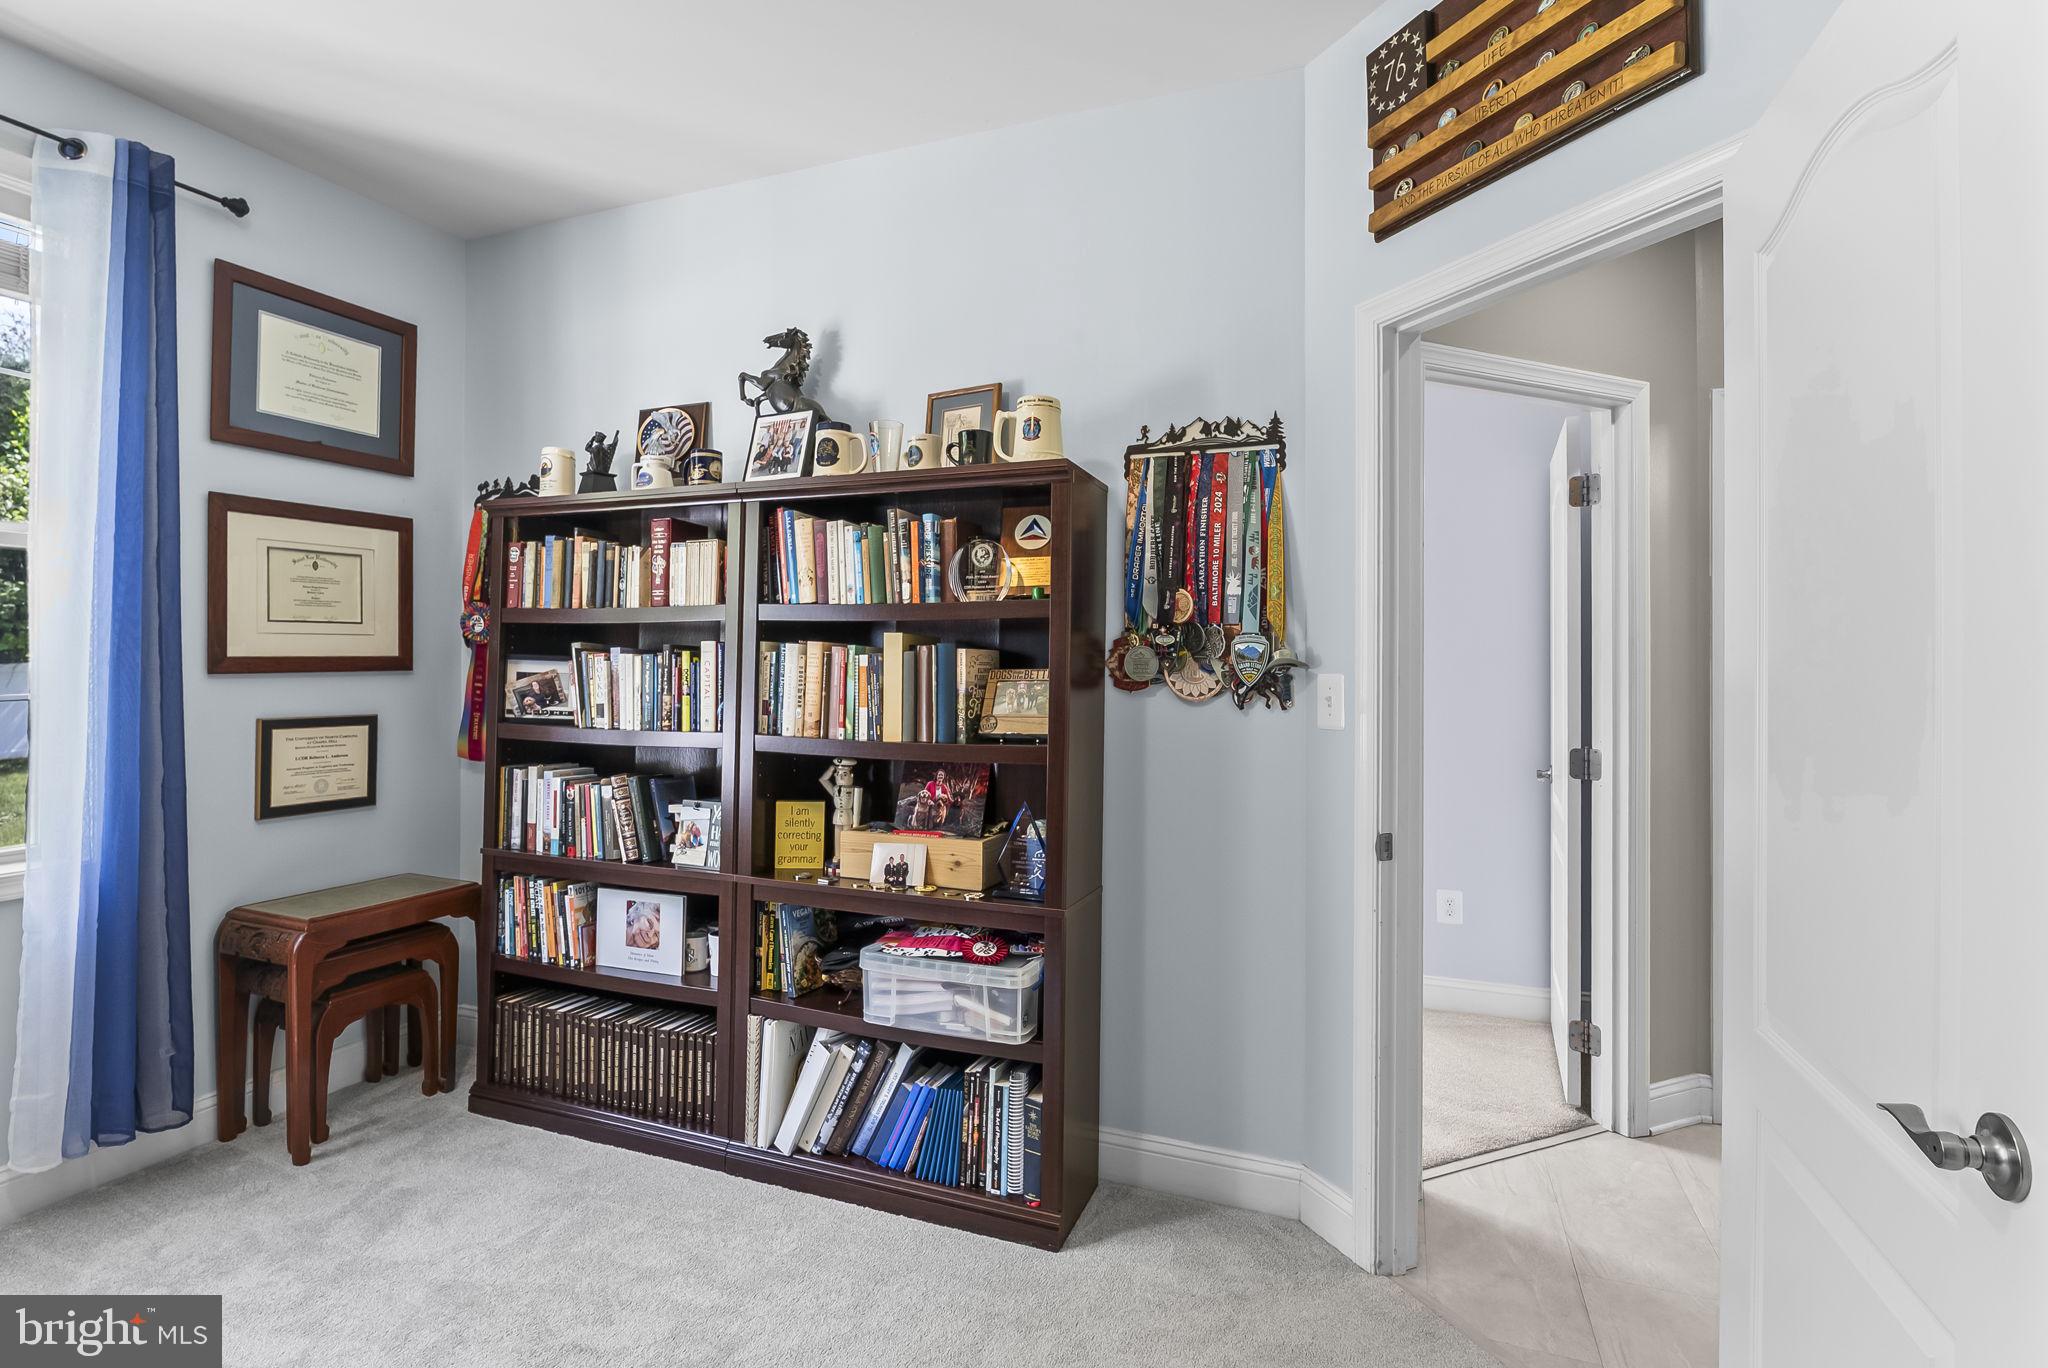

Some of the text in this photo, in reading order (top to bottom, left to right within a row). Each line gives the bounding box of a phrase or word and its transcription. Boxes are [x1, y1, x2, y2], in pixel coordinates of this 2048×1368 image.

[1482, 45, 1507, 69] LIFE
[1382, 51, 1407, 92] 76
[1474, 85, 1520, 122] LIBERTY
[1398, 76, 1625, 210] AND THE PURSUIT OF ALL WHO THREATEN IT!
[1198, 496, 1209, 590] MARATHON FINISHER
[1211, 491, 1223, 606] BALTIMORE 10 MILER 2024
[922, 540, 932, 578] PRESSURE
[1132, 545, 1142, 580] DRAPER
[990, 670, 1013, 680] DOGS
[790, 805, 810, 816] I am
[784, 817, 816, 830] silently
[777, 830, 822, 843] correcting
[789, 843, 808, 853] your
[777, 855, 820, 865] grammar.
[575, 886, 587, 896] 101
[875, 1050, 884, 1062] USS
[866, 1061, 879, 1079] George
[845, 1072, 857, 1095] DWIGHT
[961, 1117, 969, 1143] ATLAS
[993, 1132, 1001, 1164] Photography
